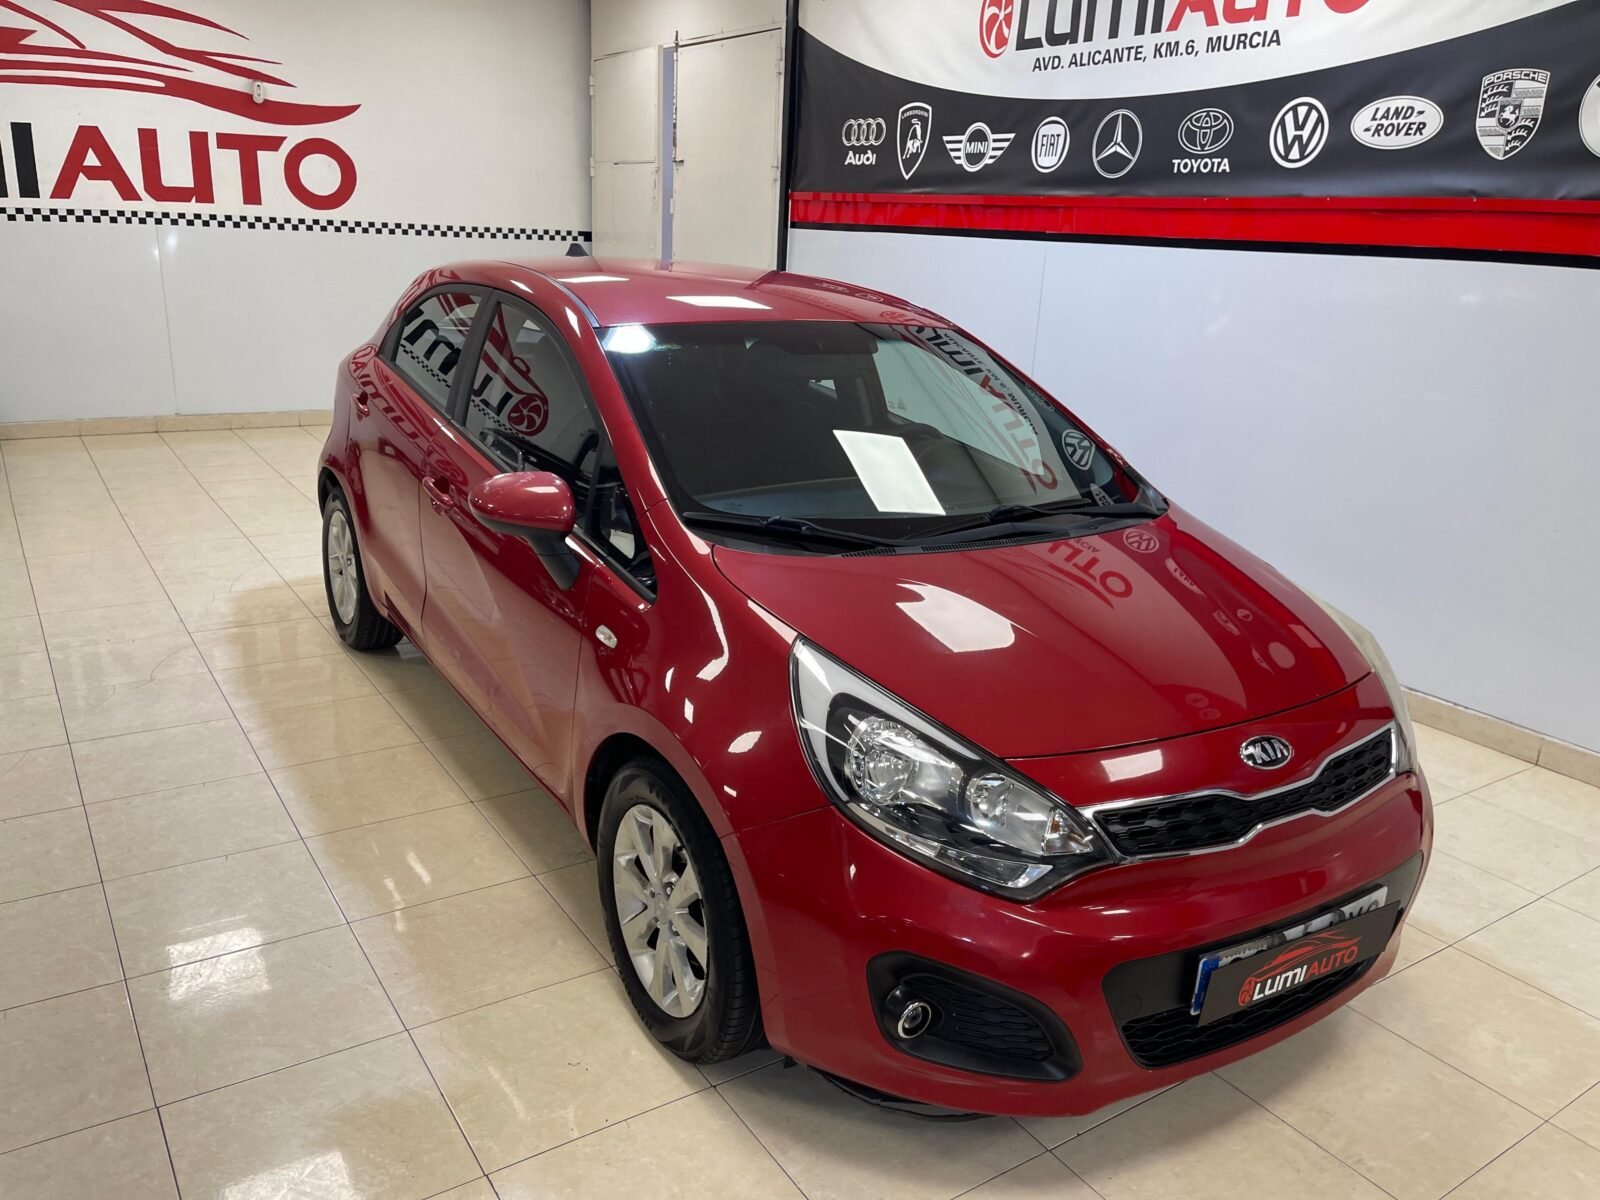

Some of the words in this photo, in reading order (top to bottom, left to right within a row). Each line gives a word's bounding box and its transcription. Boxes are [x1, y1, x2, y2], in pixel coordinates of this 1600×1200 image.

[1032, 55, 1065, 72] AVD.
[1068, 45, 1148, 69] ALICANTE,
[1153, 39, 1199, 59] KM.6,
[1206, 29, 1281, 54] MURCIA
[1484, 71, 1547, 87] PORSCHE
[966, 142, 989, 155] MINI
[1039, 135, 1062, 158] FIAT
[844, 150, 877, 165] Audi
[1172, 158, 1230, 173] TOYOTA
[1243, 739, 1289, 764] KIA
